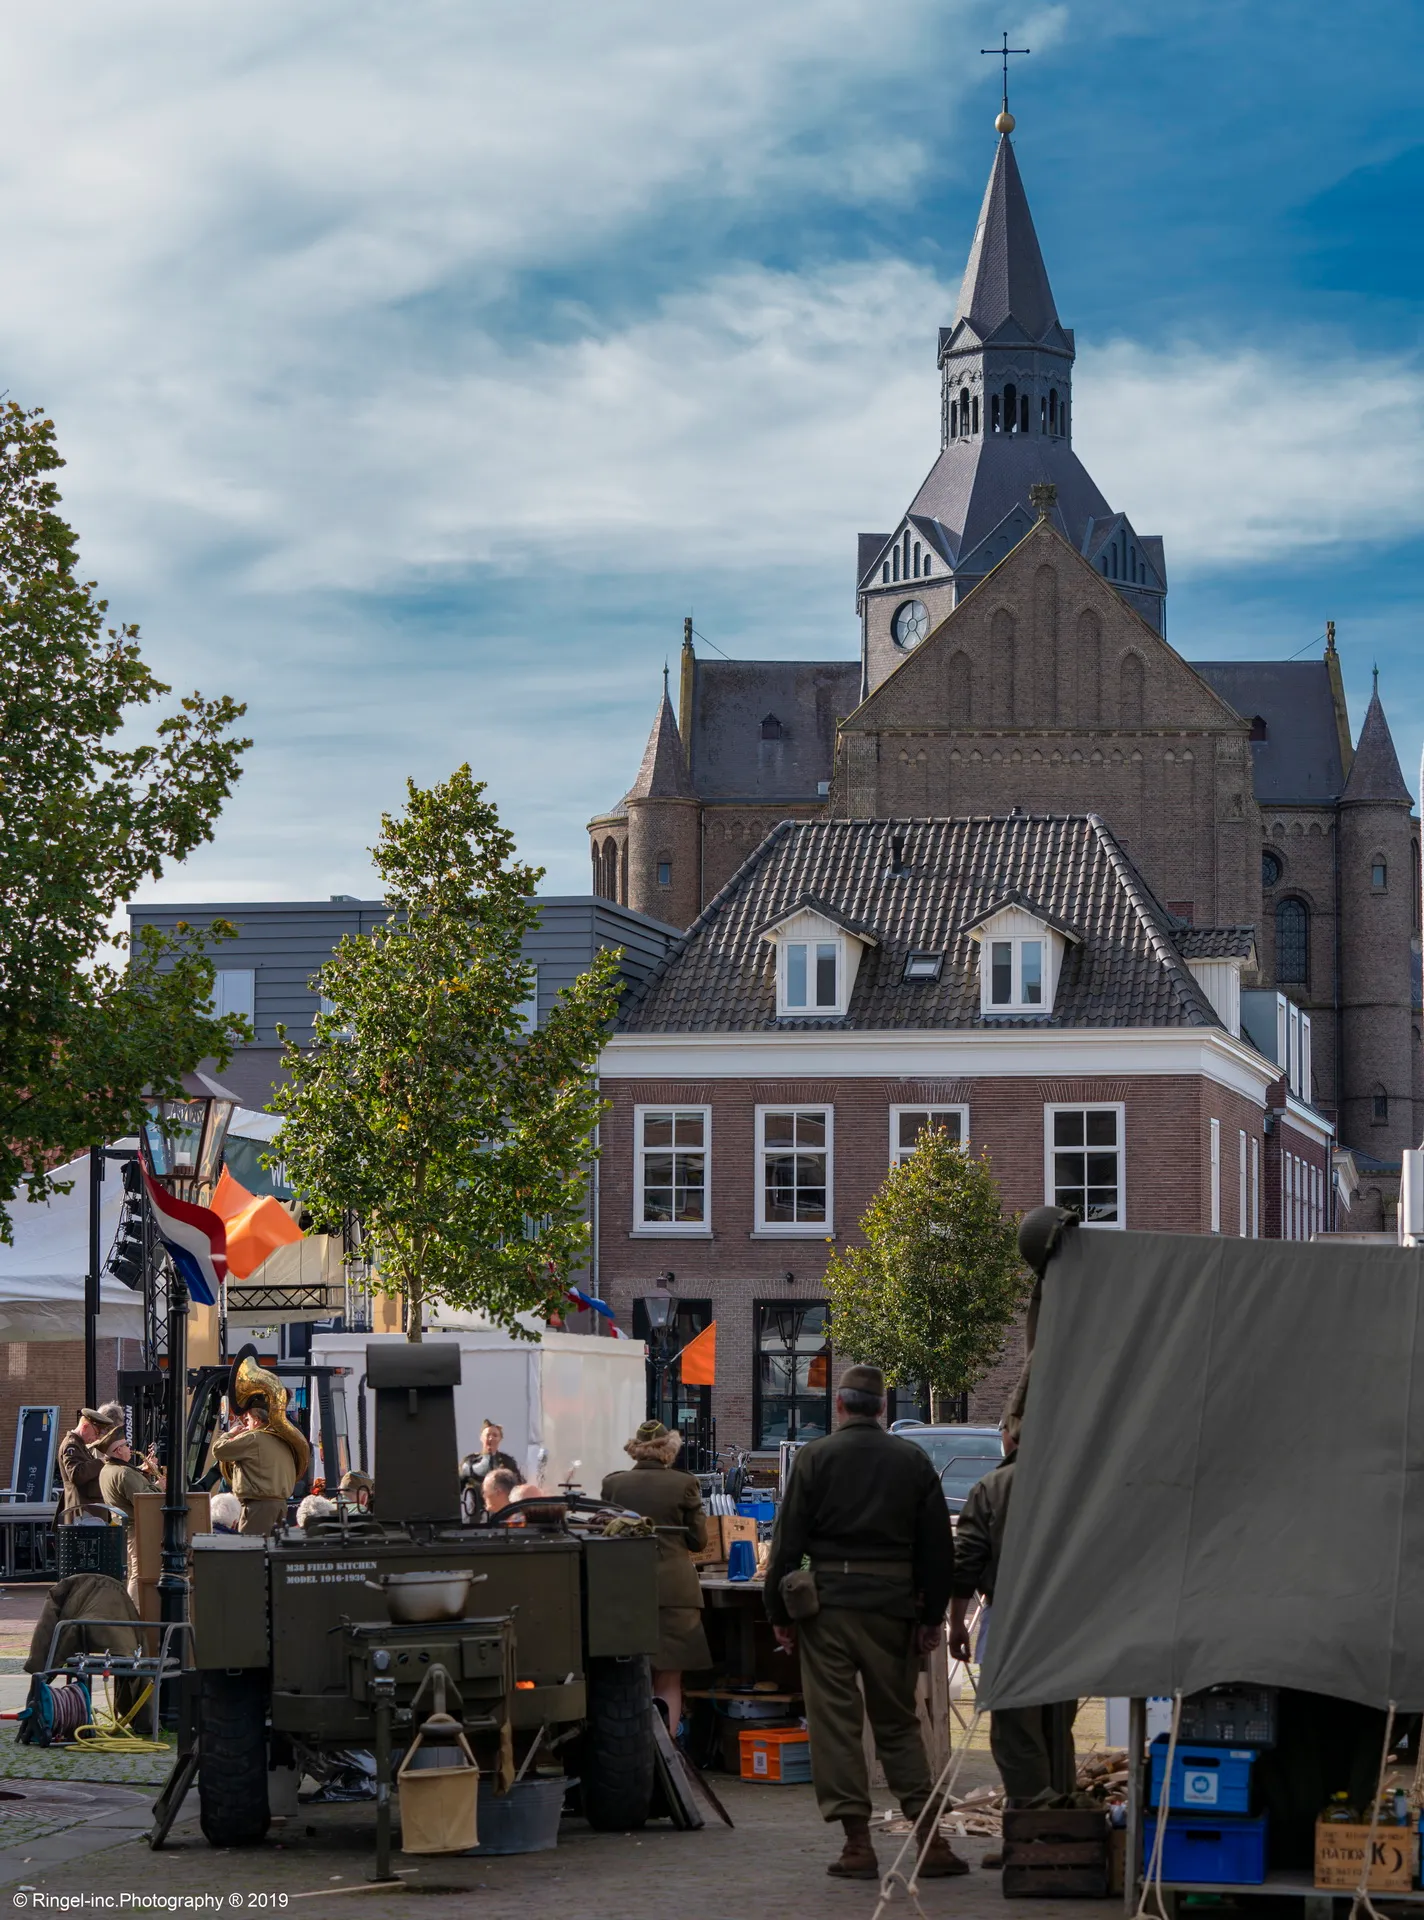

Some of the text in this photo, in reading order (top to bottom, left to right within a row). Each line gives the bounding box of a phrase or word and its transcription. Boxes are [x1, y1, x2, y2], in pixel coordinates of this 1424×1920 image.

[286, 1561, 378, 1572] M38 FIELD KITCHEN
[286, 1576, 317, 1584] MODEL
